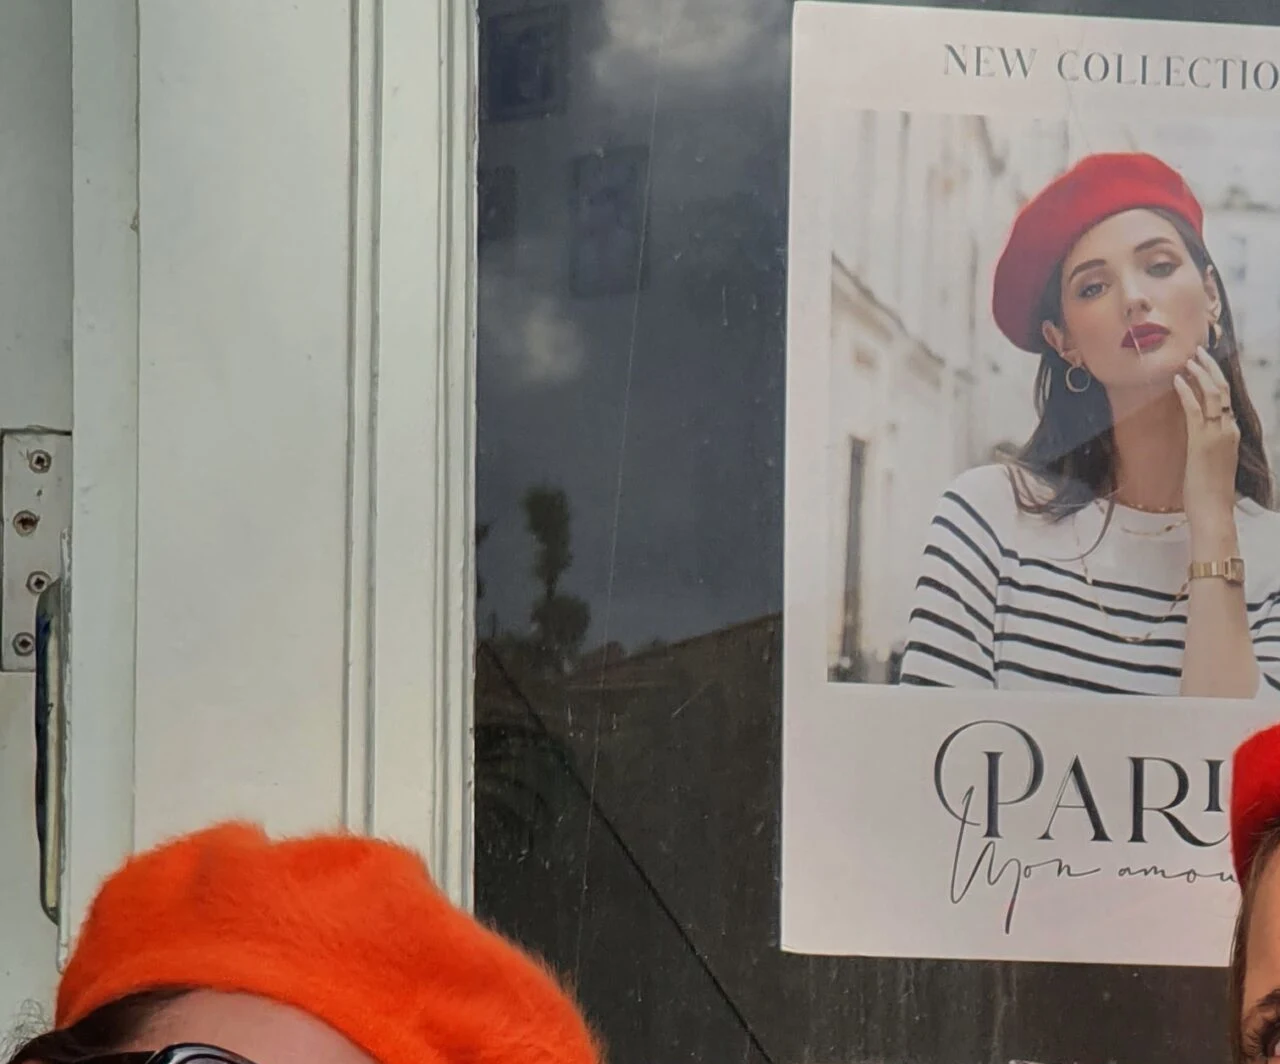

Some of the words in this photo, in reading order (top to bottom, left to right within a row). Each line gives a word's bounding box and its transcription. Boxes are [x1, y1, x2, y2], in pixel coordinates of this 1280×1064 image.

[943, 43, 1037, 78] NEW
[934, 720, 1230, 847] PARI
[950, 786, 1100, 934] Mon
[1118, 864, 1238, 884] amou
